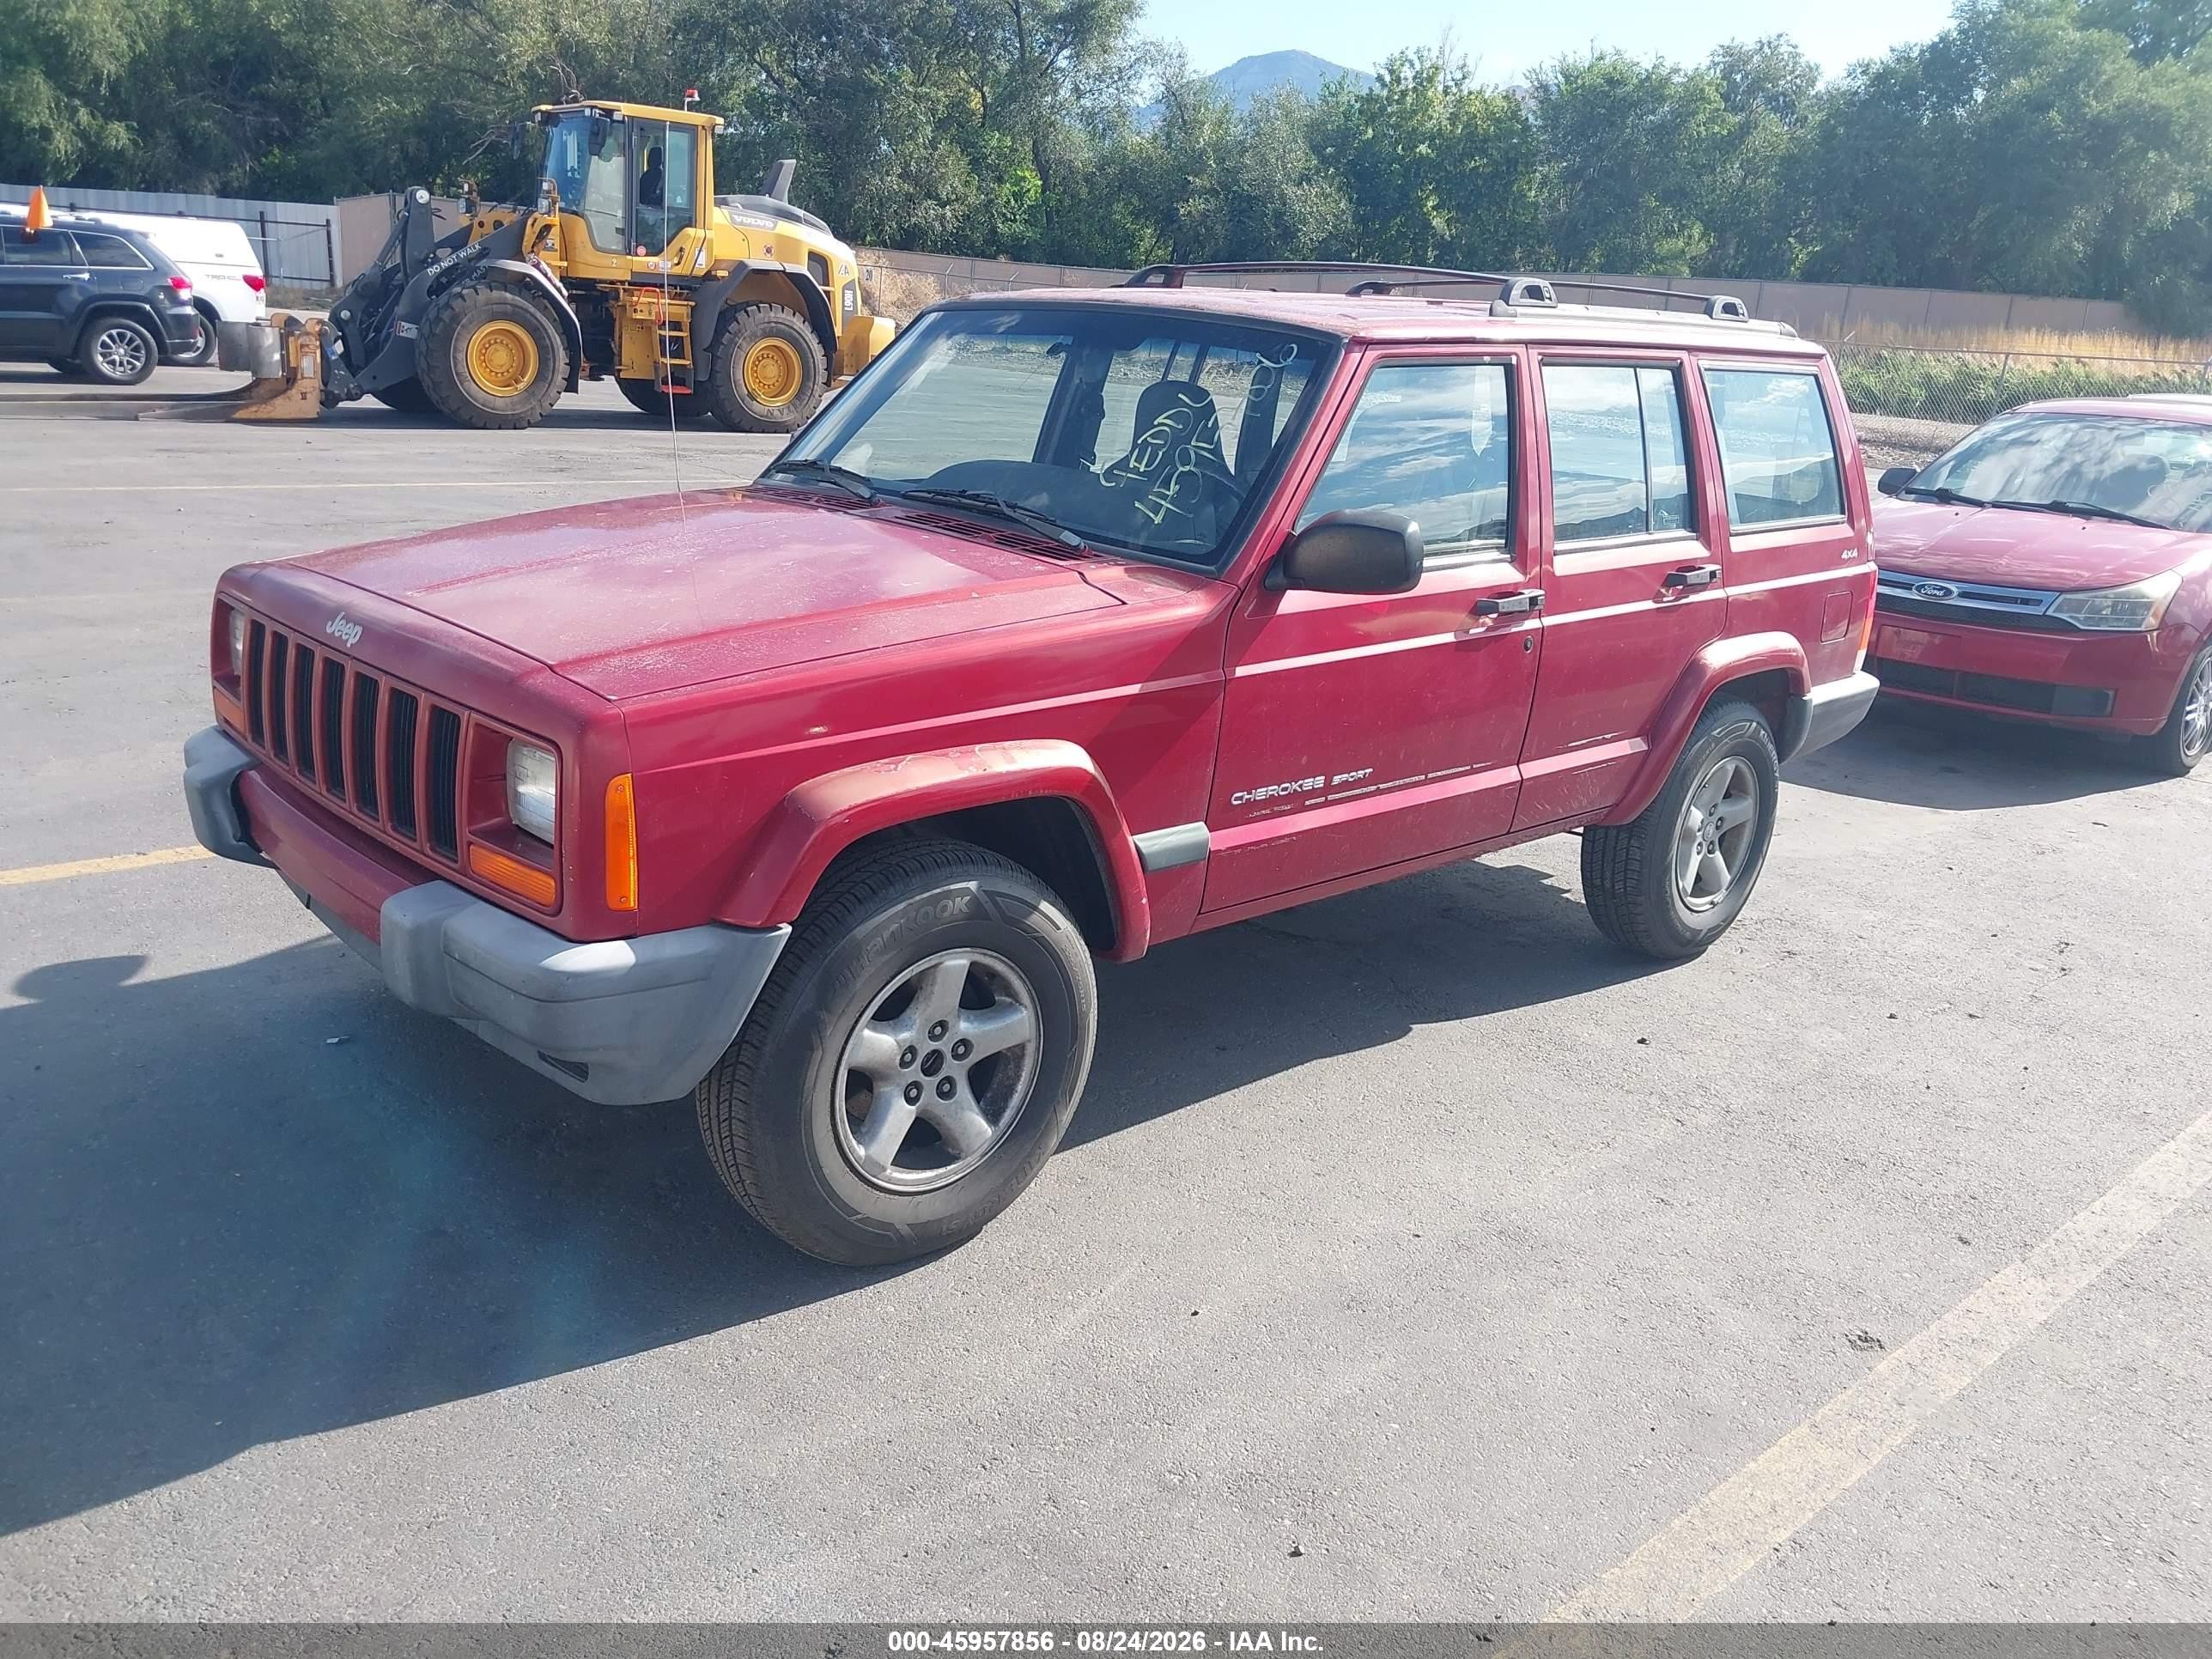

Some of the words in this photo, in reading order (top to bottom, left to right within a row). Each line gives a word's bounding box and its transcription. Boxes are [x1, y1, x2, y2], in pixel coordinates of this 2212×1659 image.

[732, 214, 775, 228] VOLVO
[427, 264, 441, 276] DO
[441, 255, 459, 269] NOT
[459, 242, 482, 258] WALK
[843, 289, 854, 311] L90H
[1920, 584, 1946, 597] Ford
[326, 611, 363, 647] Jeep
[1231, 775, 1326, 805] CHEROKEE
[1331, 768, 1374, 786] SPORT
